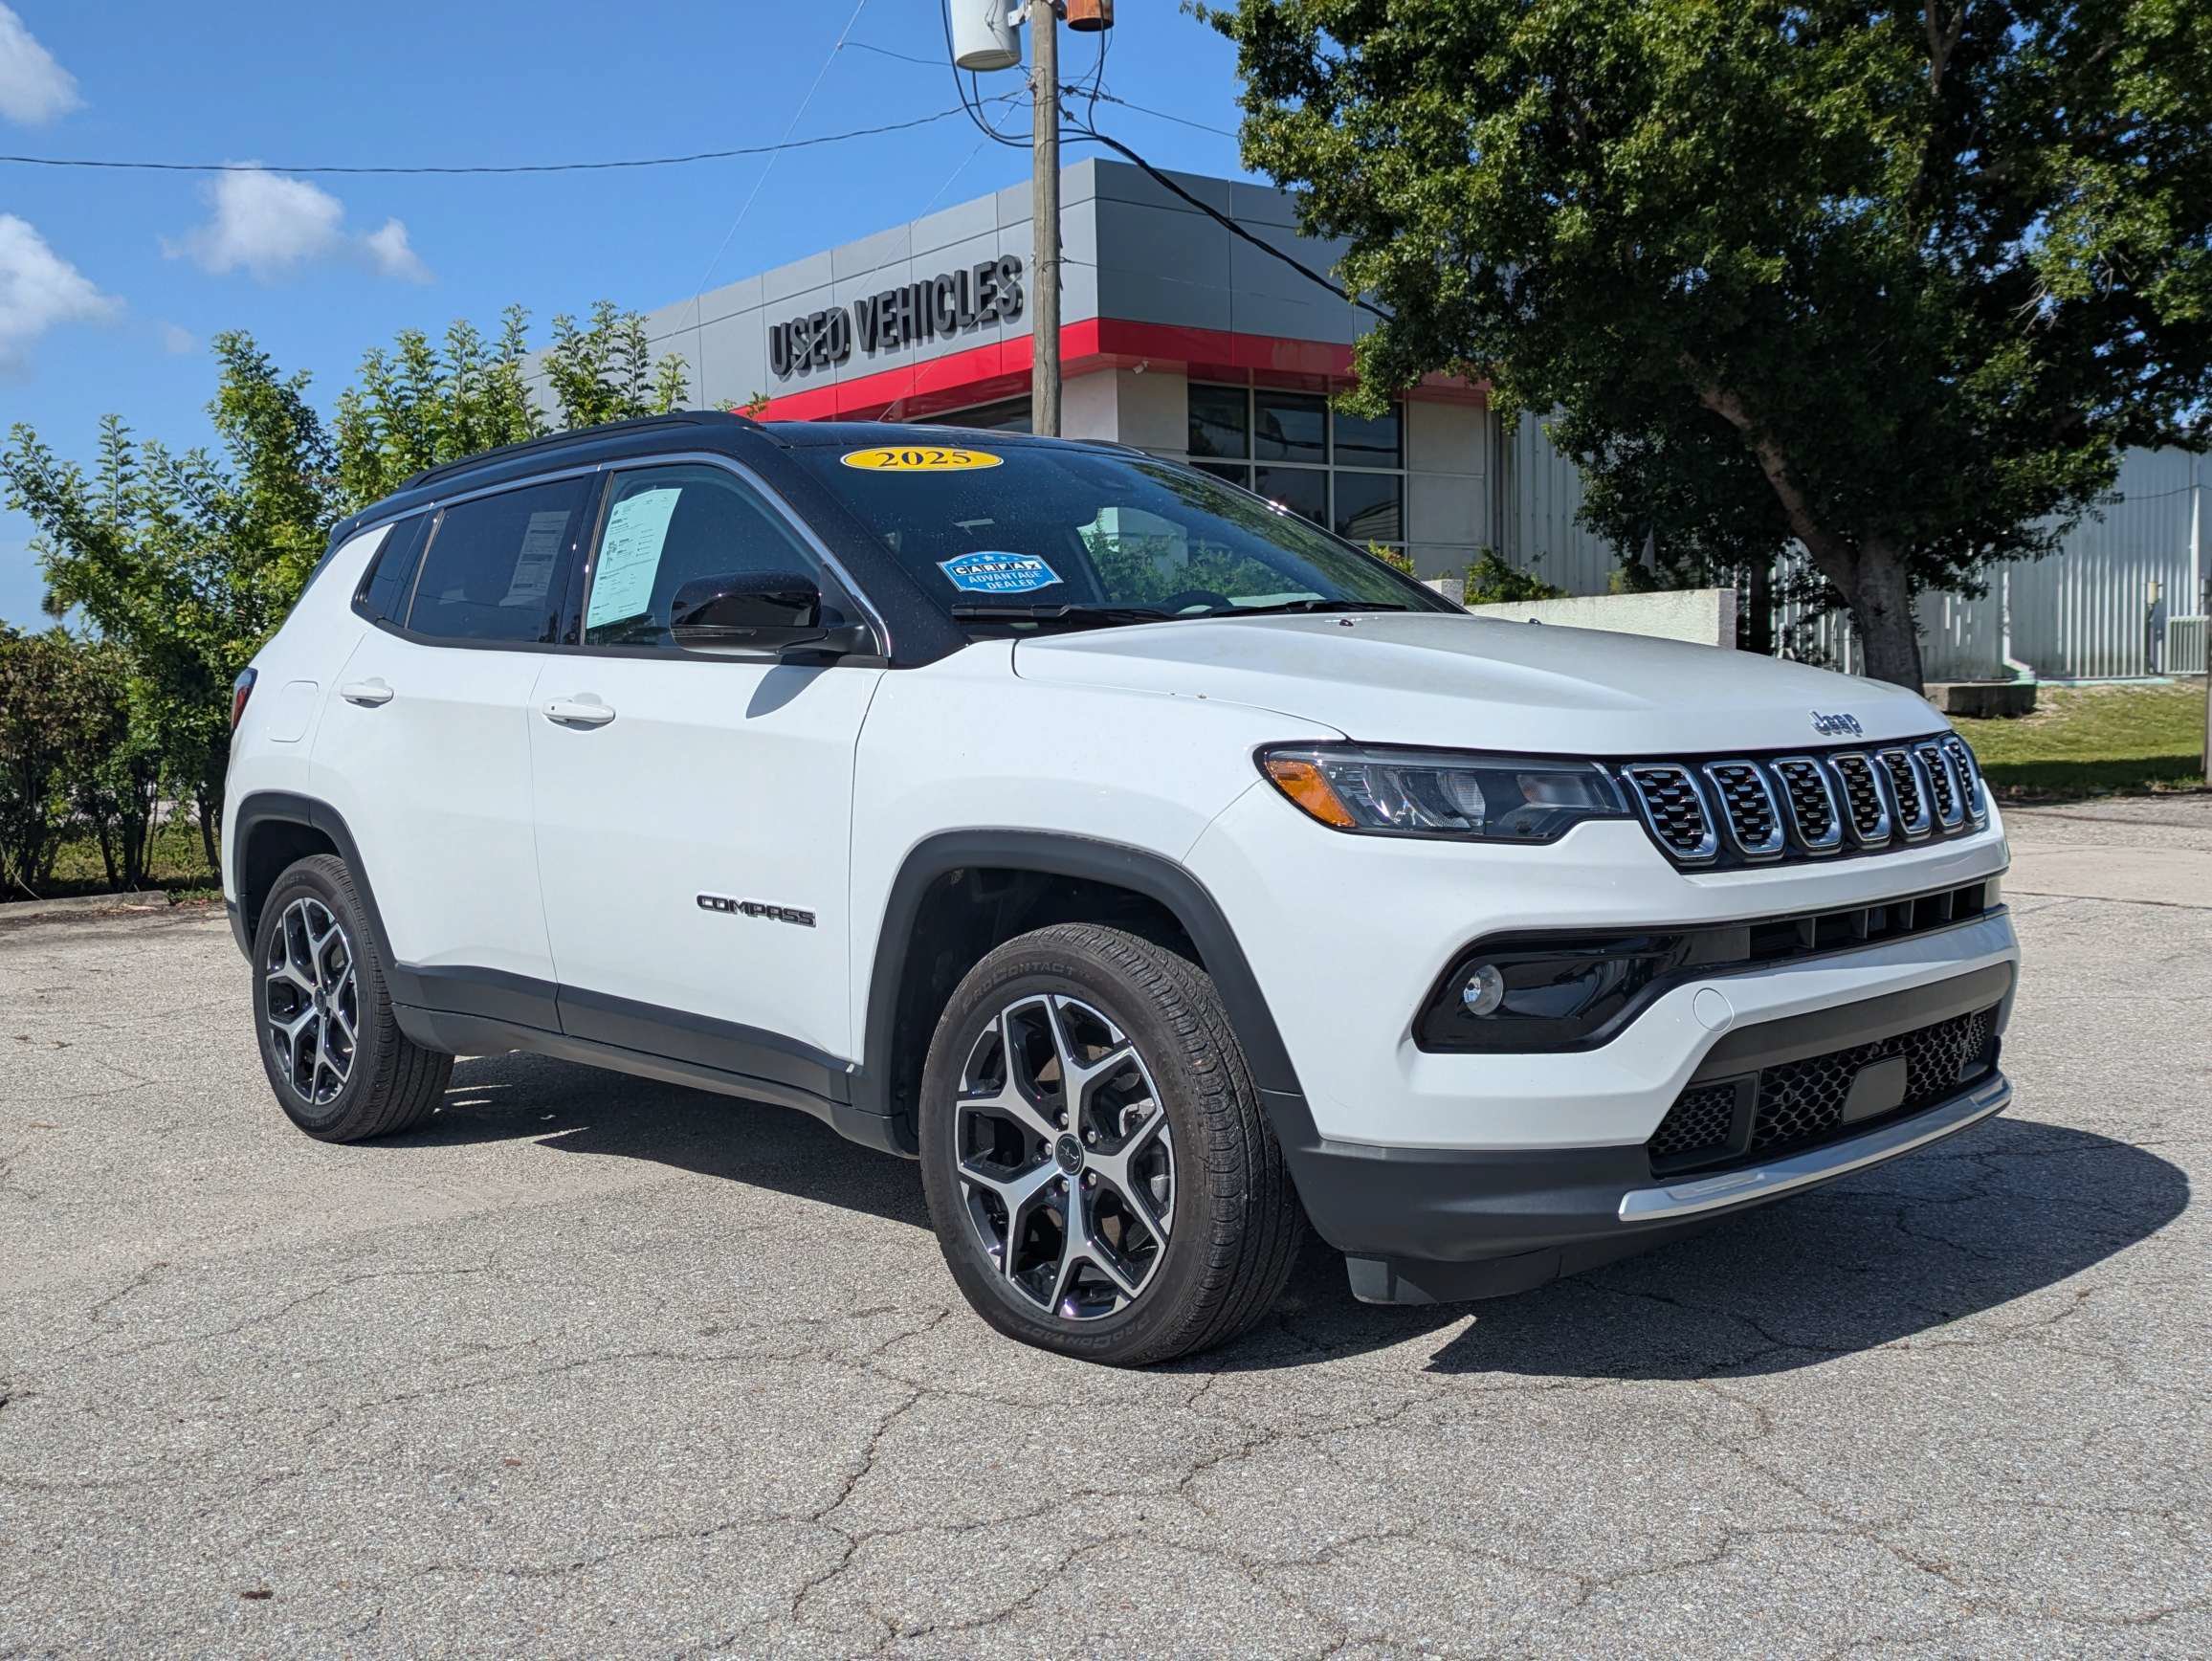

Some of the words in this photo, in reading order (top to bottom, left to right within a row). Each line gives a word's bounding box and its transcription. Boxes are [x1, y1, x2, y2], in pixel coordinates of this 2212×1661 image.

[769, 306, 851, 375] USED
[854, 255, 1023, 352] VEHICLES
[875, 451, 972, 467] 2025
[953, 561, 1043, 575] CARFAX
[968, 571, 1043, 583] ADVANTAGE
[985, 579, 1037, 589] DEALER
[1808, 710, 1863, 738] Jeep
[697, 895, 816, 927] COMPASS
